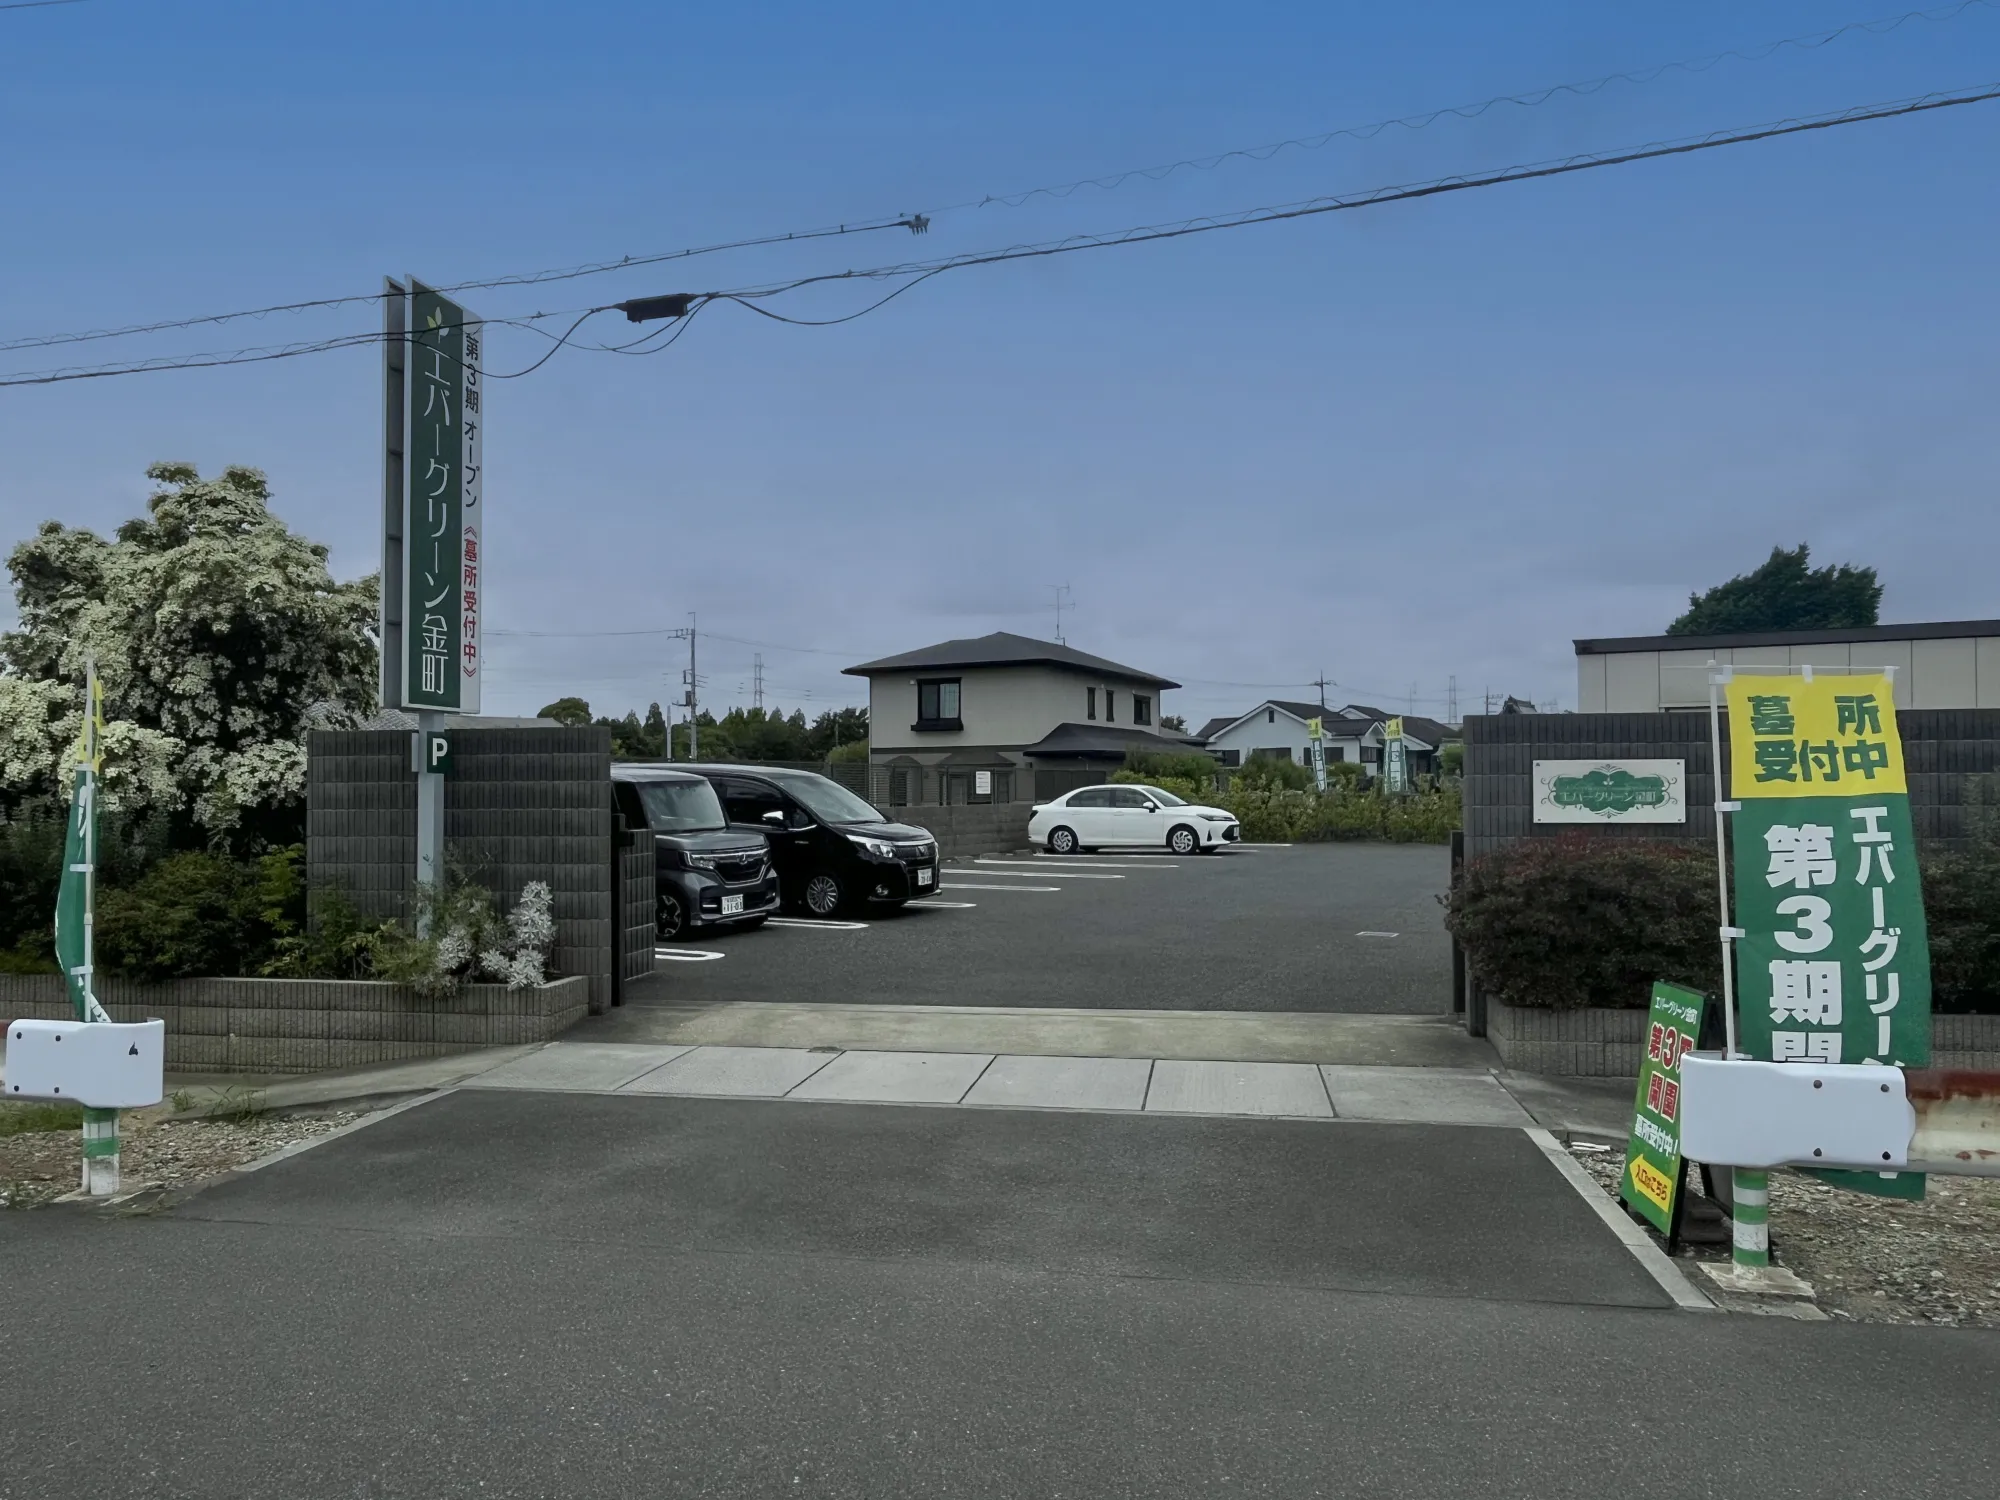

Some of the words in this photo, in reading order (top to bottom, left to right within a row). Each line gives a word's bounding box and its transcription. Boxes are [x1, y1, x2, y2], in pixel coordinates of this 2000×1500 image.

[464, 331, 480, 414] 第3期
[464, 420, 480, 508] オープン
[423, 345, 450, 695] エバーグリーン金町
[432, 737, 448, 766] P
[1754, 739, 1889, 783] 受付中
[1850, 806, 1905, 1066] エバーグリー
